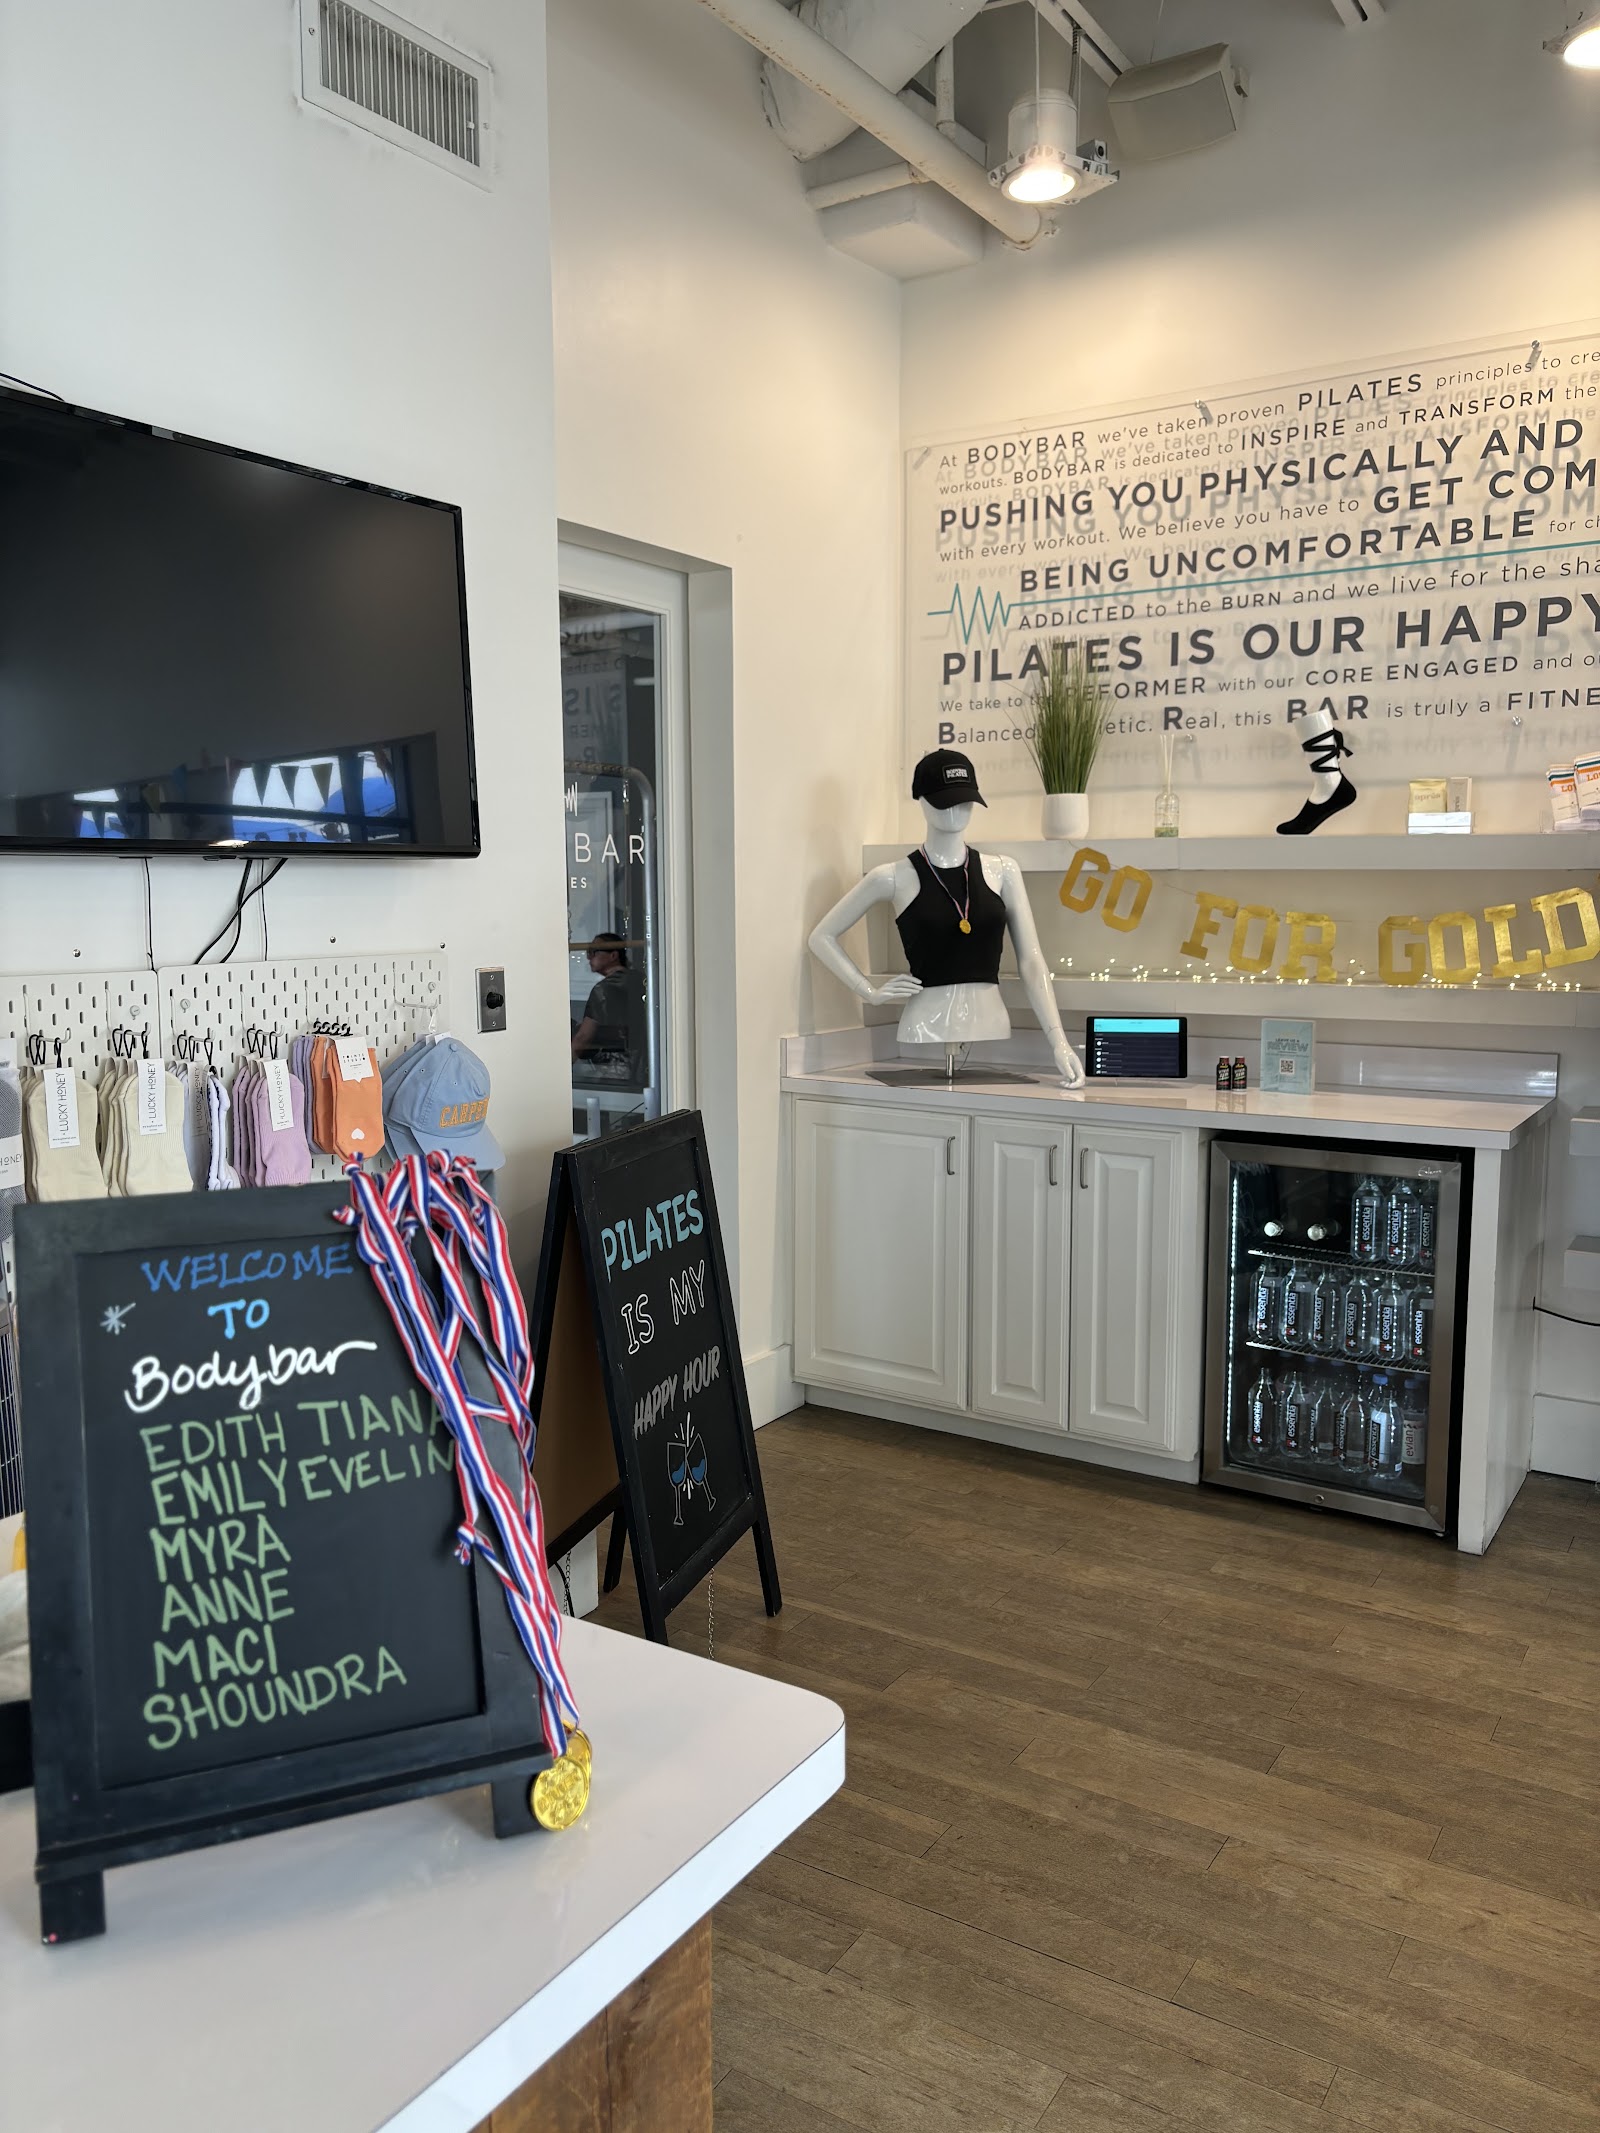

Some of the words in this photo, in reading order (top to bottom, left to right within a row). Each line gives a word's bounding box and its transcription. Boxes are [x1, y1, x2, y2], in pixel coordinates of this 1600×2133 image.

[940, 456, 957, 469] At
[968, 431, 1086, 464] BODYBAR
[1098, 427, 1149, 444] we've
[1157, 418, 1208, 434] taken
[1217, 403, 1285, 427] proven
[1298, 374, 1422, 411] PILATES
[1436, 362, 1532, 389] principles
[1542, 358, 1561, 370] to
[940, 476, 1007, 495] workouts.
[1014, 459, 1105, 484] BODYBAR
[1114, 459, 1126, 470] is
[1132, 444, 1211, 467] dedicated
[1218, 443, 1234, 455] to
[1242, 419, 1346, 450] INSPIRE
[1355, 415, 1388, 433] and
[1399, 388, 1554, 425] TRANSFORM
[1565, 386, 1597, 400] the
[940, 490, 1093, 533] PUSHING
[1108, 477, 1183, 510] YOU
[1200, 435, 1463, 498] PHYSICALLY
[1480, 418, 1583, 460] AND
[940, 547, 974, 562] with
[981, 542, 1026, 558] every
[1034, 532, 1110, 550] workout.
[1119, 526, 1146, 541] We
[1155, 517, 1225, 536] believe
[1234, 511, 1270, 529] you
[1280, 503, 1328, 521] have
[1338, 498, 1360, 514] to
[1374, 476, 1463, 514] GET
[1488, 458, 1597, 499] COM
[1021, 559, 1129, 593] BEING
[1150, 509, 1535, 578] UNCOMFORTABLE
[1549, 520, 1576, 533] for
[1019, 605, 1135, 630] ADDICTED
[1146, 604, 1166, 618] to
[1177, 599, 1211, 614] the
[1222, 591, 1281, 610] BURN
[1293, 584, 1335, 604] and
[1347, 583, 1380, 598] we
[1391, 576, 1437, 594] live
[1450, 569, 1488, 588] for
[1501, 563, 1546, 582] the
[943, 635, 1143, 685] PILATES
[1170, 629, 1215, 666] IS
[1243, 616, 1365, 660] OUR
[940, 701, 963, 712] We
[969, 697, 1001, 711] take
[1008, 697, 1023, 708] to
[1218, 678, 1256, 692] with
[1264, 676, 1294, 689] our
[1305, 666, 1373, 686] CORE
[1386, 656, 1518, 681] ENGAGED
[1533, 653, 1572, 670] and
[1163, 706, 1226, 731] Real,
[1235, 711, 1272, 727] this
[1387, 703, 1403, 718] is
[1414, 699, 1468, 717] truly
[1479, 700, 1491, 712] a
[1059, 847, 1153, 933] GO
[1179, 891, 1337, 983] FOR
[1378, 887, 1600, 986] GOLD
[55, 1072, 67, 1101] HONEY
[147, 1062, 157, 1090] HONEY
[148, 1091, 157, 1119] LUCKY
[58, 1103, 69, 1132] LUCKY
[601, 1189, 704, 1283] PILATES
[1362, 1206, 1371, 1241] essentia
[1391, 1209, 1400, 1244] essentia
[1422, 1212, 1431, 1247] essentia
[141, 1242, 354, 1292] WELCOME
[207, 1298, 270, 1340] TO
[620, 1293, 655, 1356] IS
[669, 1259, 707, 1327] MY
[1287, 1292, 1297, 1326] essentia
[1346, 1302, 1355, 1336] essentia
[1382, 1306, 1391, 1341] essentia
[1414, 1310, 1423, 1345] essentia
[124, 1340, 378, 1414] Bodybar
[633, 1373, 678, 1441] HAPPY
[682, 1345, 721, 1403] HOUR
[140, 1411, 287, 1474] EDITH
[1287, 1404, 1297, 1438] essentia
[1405, 1429, 1414, 1458] evian
[151, 1457, 287, 1526] EMILY
[149, 1514, 292, 1583] MYRA
[161, 1568, 295, 1633] ANNE
[153, 1623, 278, 1689] MACI
[143, 1645, 408, 1751] SHOUNDRA
